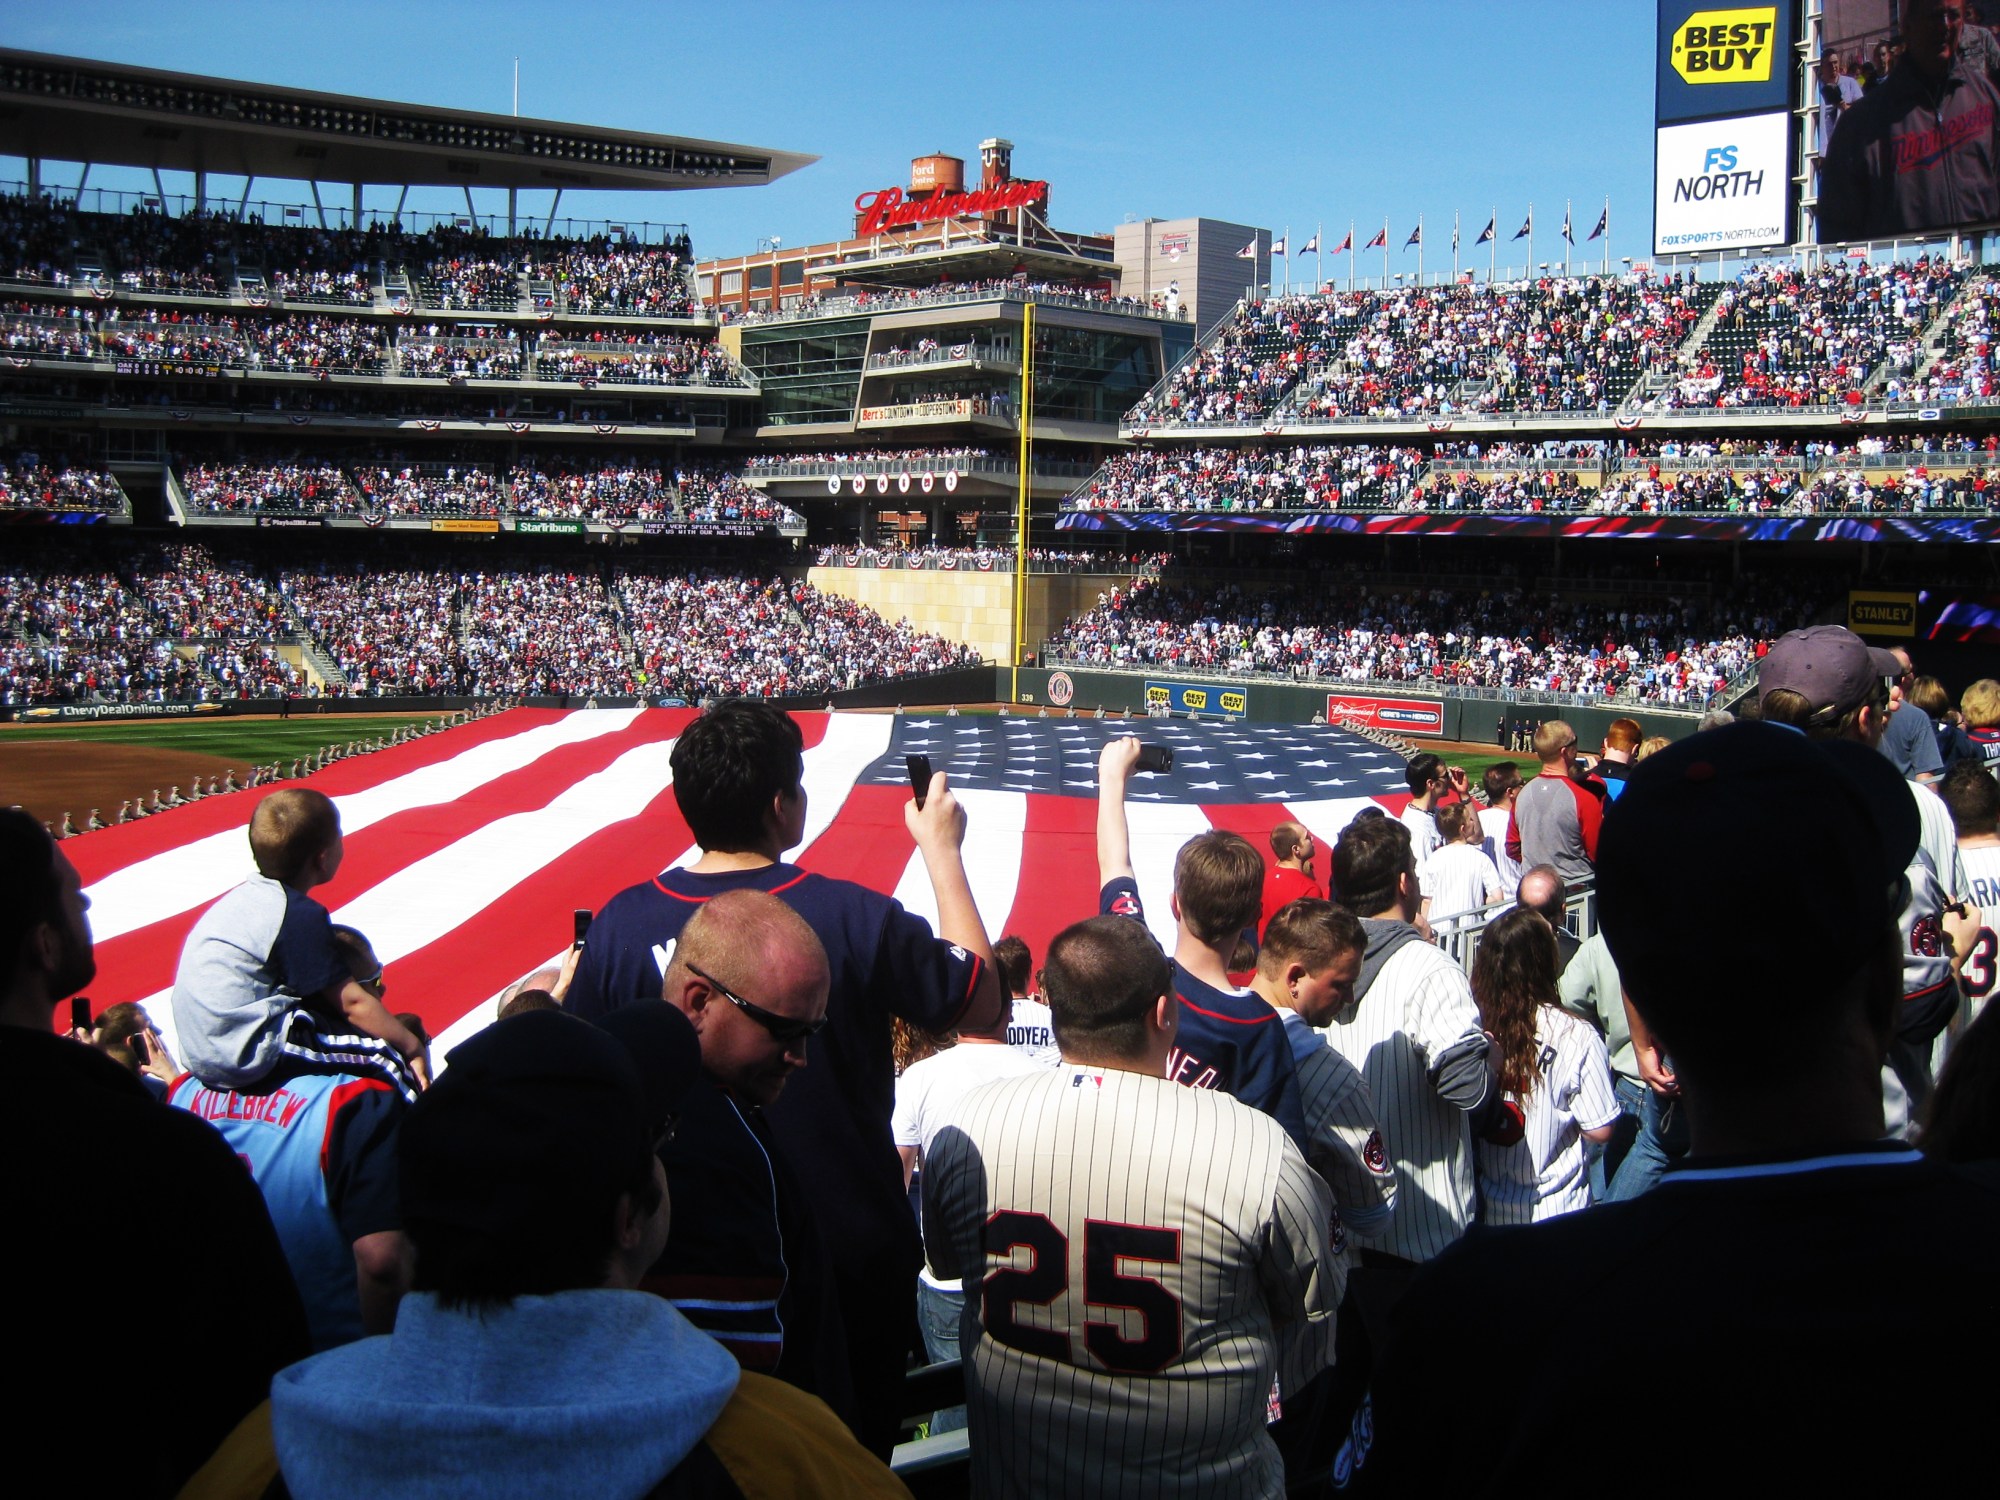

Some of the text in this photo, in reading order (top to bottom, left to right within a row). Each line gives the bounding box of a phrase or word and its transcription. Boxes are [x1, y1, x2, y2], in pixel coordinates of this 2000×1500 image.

[1685, 22, 1771, 48] BEST
[1686, 48, 1762, 73] BUY
[1703, 145, 1738, 173] FS
[912, 162, 935, 176] Ford
[1674, 170, 1764, 203] NORTH
[854, 176, 1047, 234] Budweiser
[862, 408, 884, 421] Bert's
[884, 406, 913, 420] COUNTDOWN
[919, 402, 956, 417] COOPERSTOWN
[520, 522, 577, 533] StarTribune
[1856, 606, 1908, 621] STANLEY
[1021, 693, 1033, 702] 339
[1149, 687, 1169, 697] BEST
[1185, 691, 1206, 701] BEST
[1223, 694, 1243, 704] BEST
[1186, 698, 1203, 706] BUY
[1223, 700, 1241, 709] BUY
[63, 704, 190, 717] ChevyDealOnline.com
[1332, 704, 1376, 716] Budweiser
[1380, 710, 1400, 719] HERE'S
[1412, 712, 1436, 721] HEROES
[1165, 1046, 1222, 1090] NEA
[983, 1209, 1182, 1373] 25
